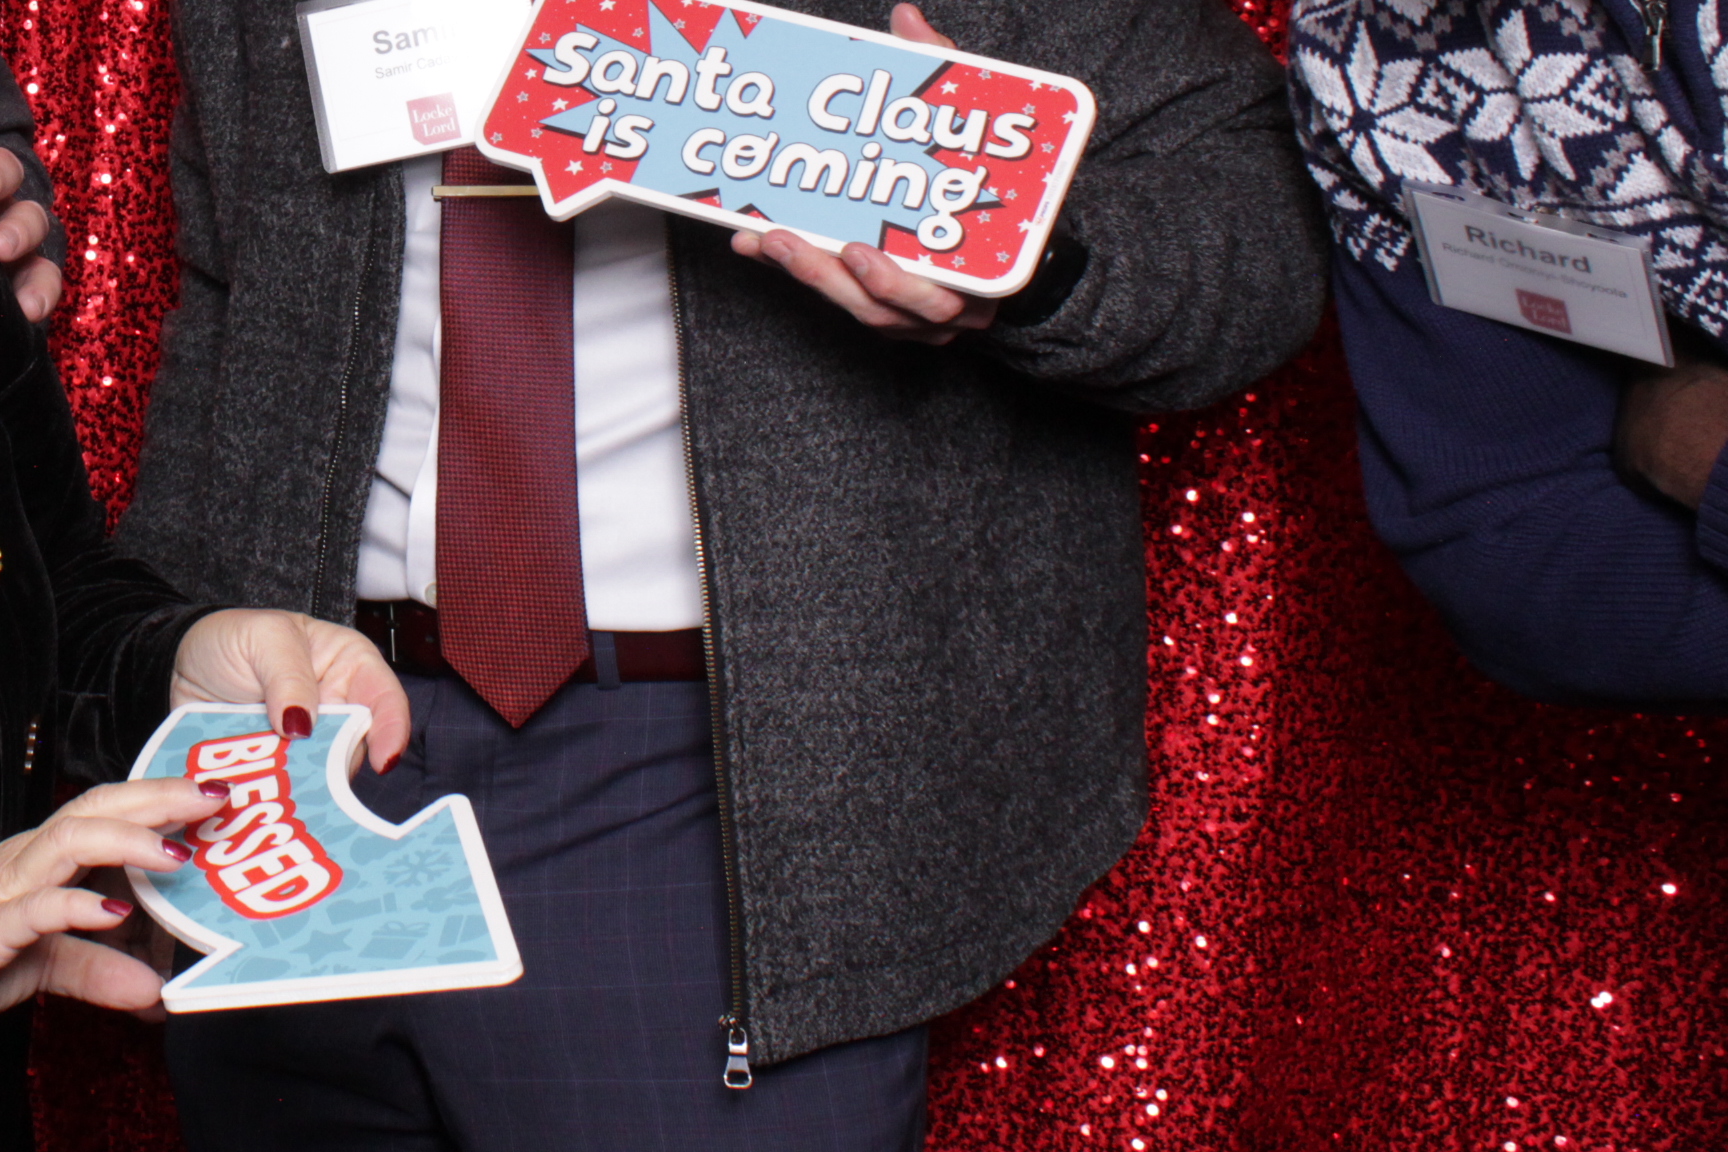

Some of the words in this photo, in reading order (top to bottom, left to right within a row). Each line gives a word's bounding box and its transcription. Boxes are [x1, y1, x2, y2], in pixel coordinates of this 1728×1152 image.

[374, 60, 413, 80] Samir
[542, 31, 777, 119] Santa
[807, 69, 1038, 160] Claus
[411, 104, 453, 124] Locke
[422, 118, 457, 137] Lord
[581, 97, 655, 160] is
[680, 127, 989, 254] coming
[1442, 242, 1496, 265] Richard
[1464, 225, 1592, 274] Richard
